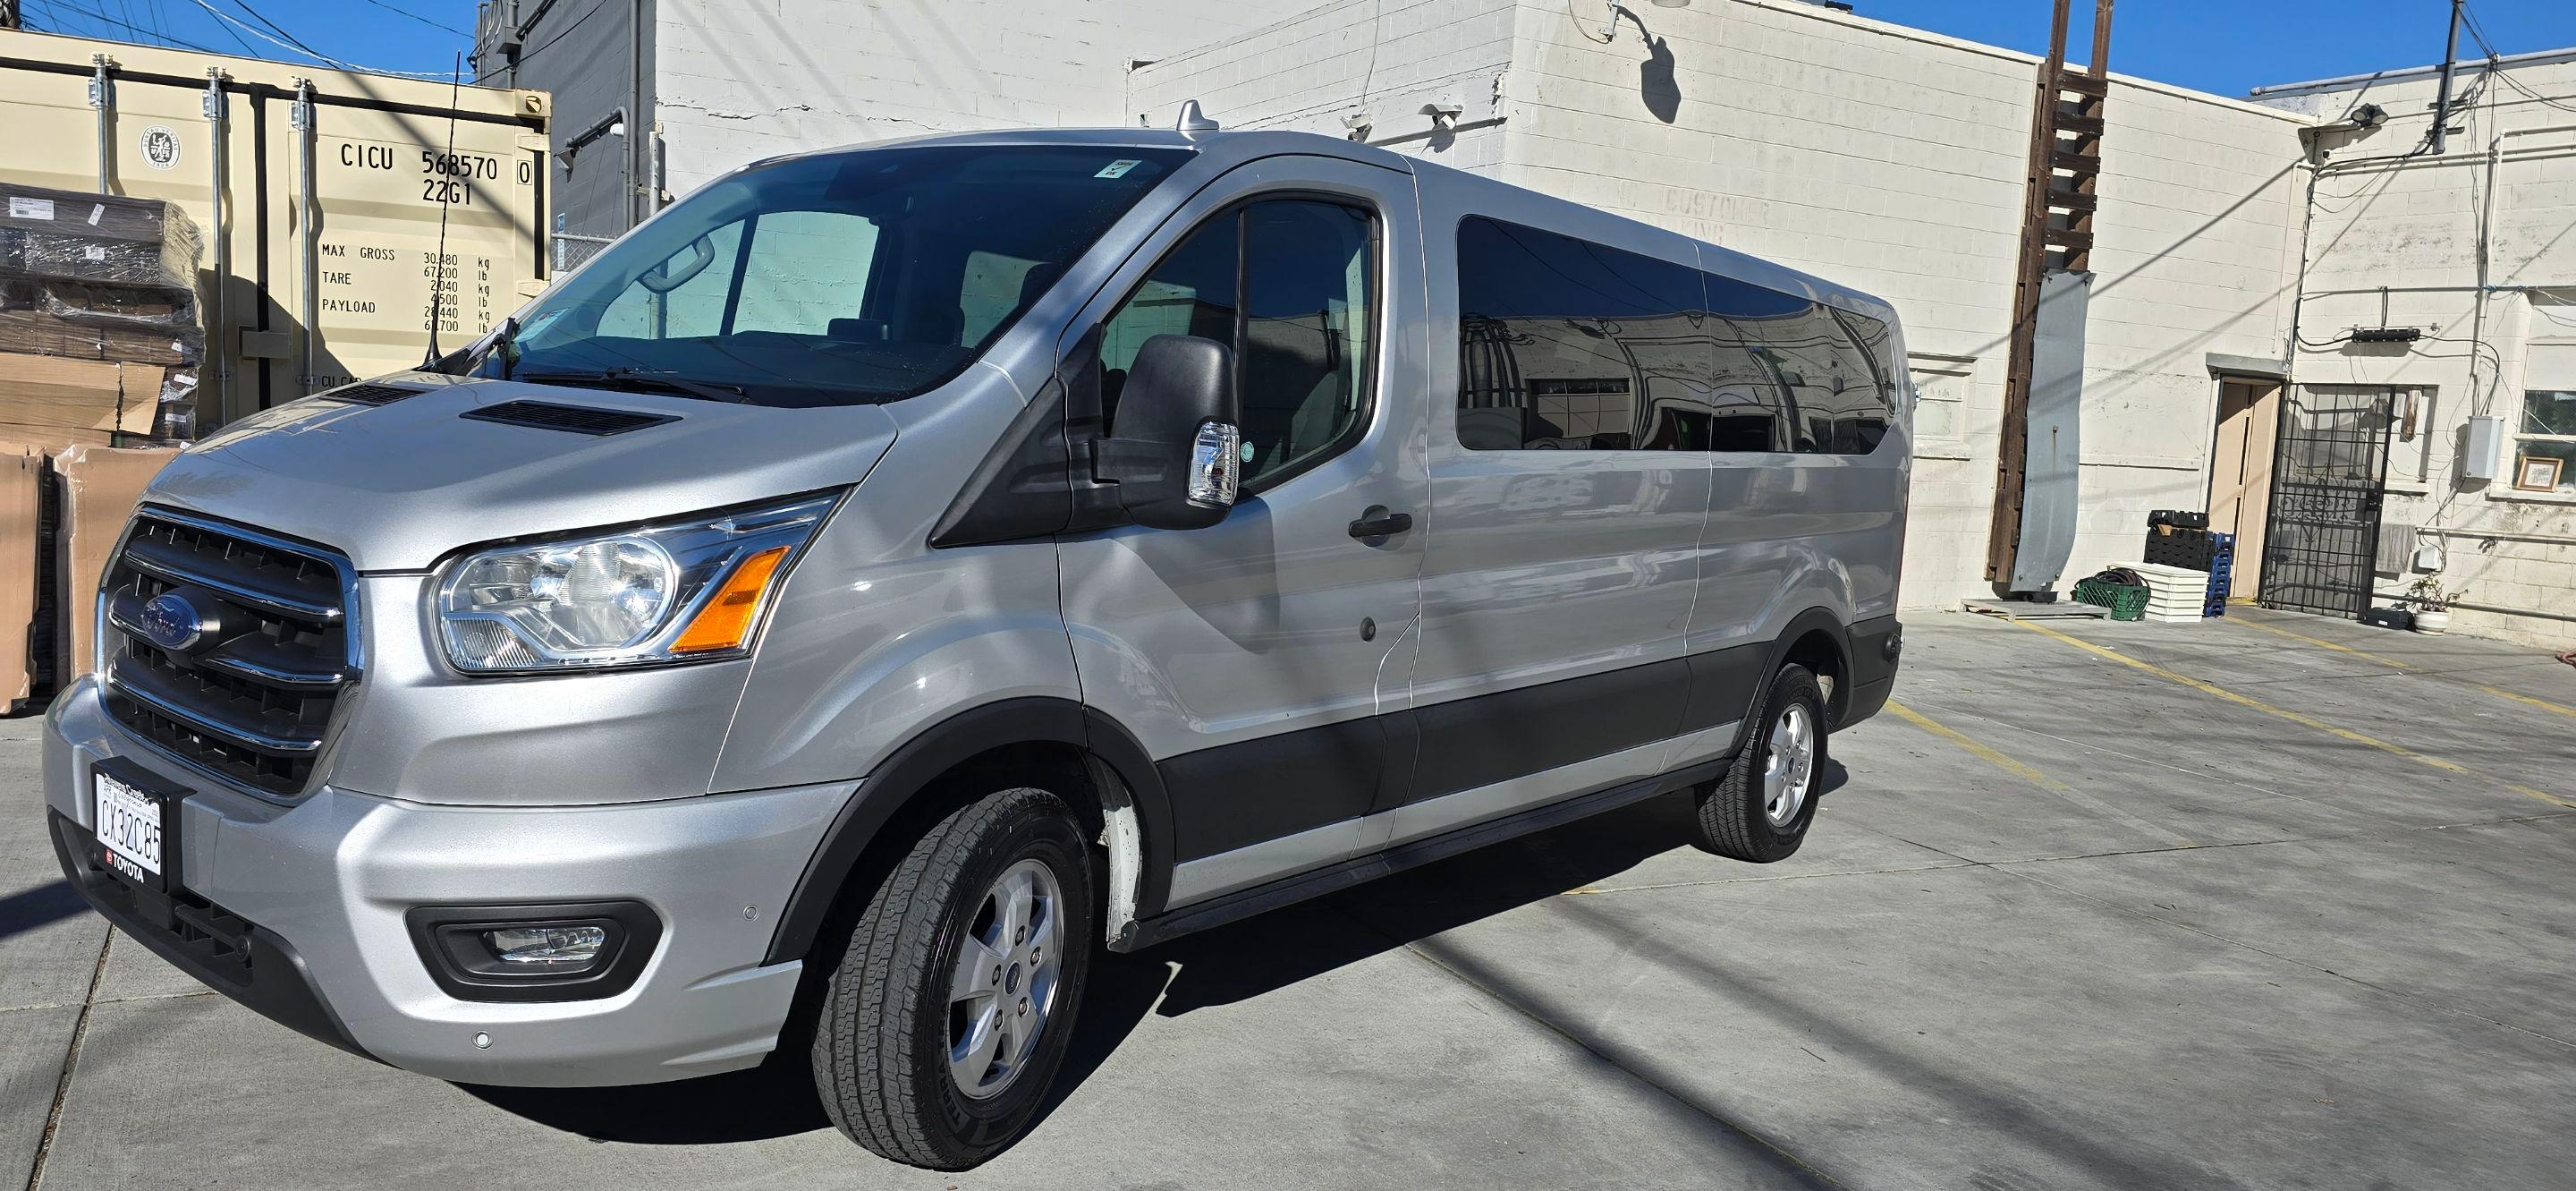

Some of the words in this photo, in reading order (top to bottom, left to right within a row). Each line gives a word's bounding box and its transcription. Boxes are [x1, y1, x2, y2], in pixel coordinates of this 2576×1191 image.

[341, 144, 393, 169] CICU
[422, 151, 497, 180] 568570
[520, 162, 530, 183] 0
[423, 179, 470, 205] 22G1
[322, 244, 345, 257] MAX
[360, 247, 395, 260] GROSS
[478, 257, 490, 270] kg
[322, 271, 352, 285] TARE
[430, 280, 458, 292] 2040
[478, 284, 490, 297] kg
[479, 270, 487, 281] lb
[322, 299, 376, 313] PAYLOAD
[424, 306, 459, 319] 2440
[479, 310, 490, 323] kg
[430, 293, 458, 305] 4500
[479, 296, 487, 308] lb
[424, 320, 459, 332] 6.700
[479, 323, 487, 334] lb
[102, 799, 161, 865] CX32C85
[113, 853, 144, 883] TOYOTA
